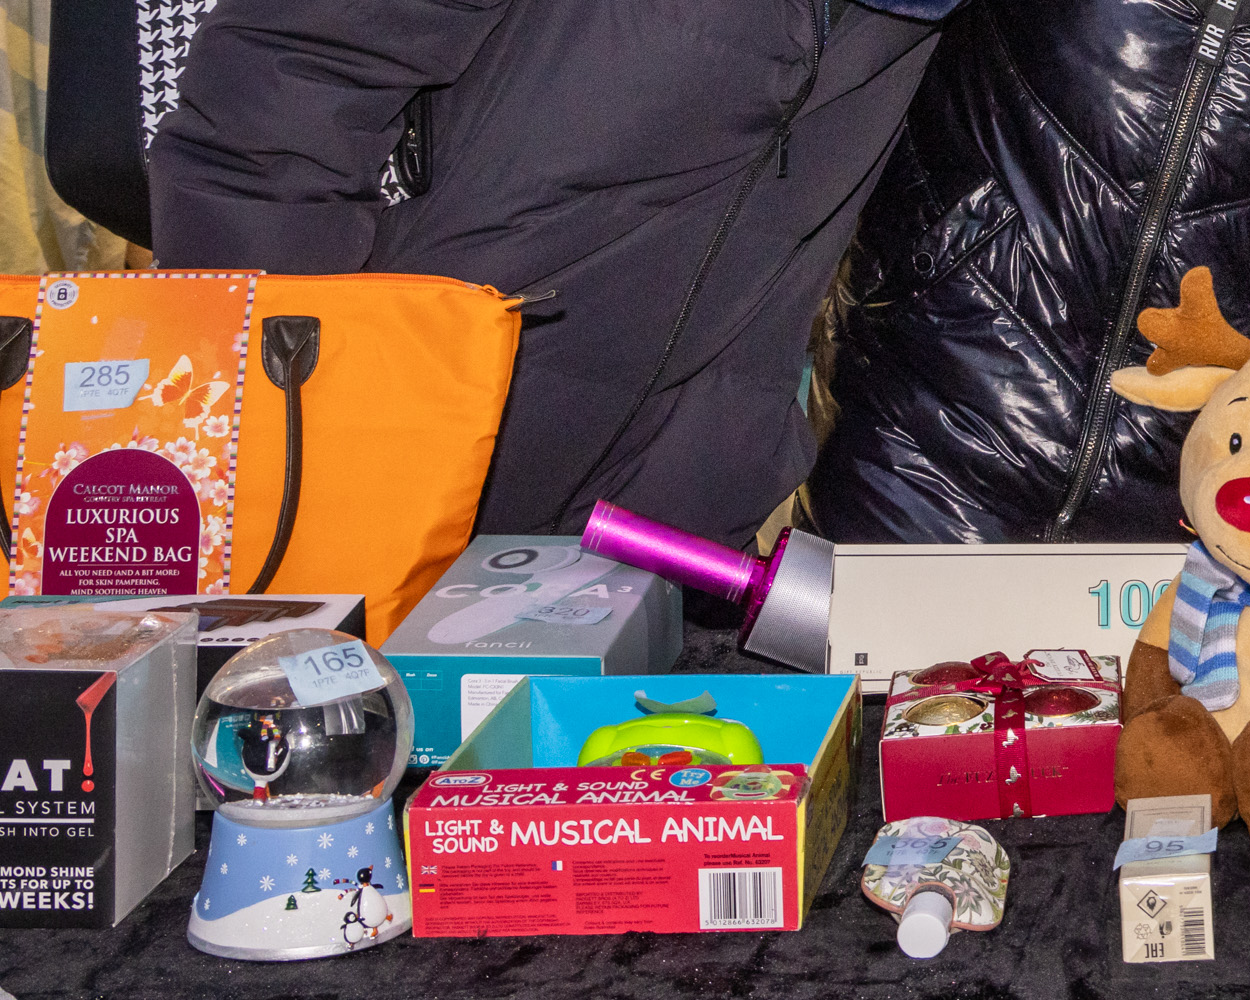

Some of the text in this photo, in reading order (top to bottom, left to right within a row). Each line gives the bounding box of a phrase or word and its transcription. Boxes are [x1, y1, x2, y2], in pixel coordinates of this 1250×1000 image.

[1198, 23, 1226, 60] RVR
[79, 364, 130, 388] 285
[66, 508, 180, 524] LUXURIOUS
[106, 528, 139, 544] SPA
[48, 546, 192, 562] WEEKEND BAG
[538, 606, 590, 617] 320
[304, 647, 364, 676] 165
[679, 778, 700, 786] Me
[680, 770, 706, 779] Try
[482, 781, 649, 794] LIGHT & SOUND
[430, 790, 696, 806] MUSICAL ANIMAL
[15, 801, 96, 814] SYSTEM
[23, 827, 95, 838] INTO GEL
[424, 819, 504, 836] LIGHT &
[510, 815, 784, 846] MUSICAL ANIMAL
[432, 836, 498, 854] SOUND
[1145, 840, 1184, 853] 95
[50, 866, 95, 878] SHINE
[20, 879, 95, 890] FOR UP TO
